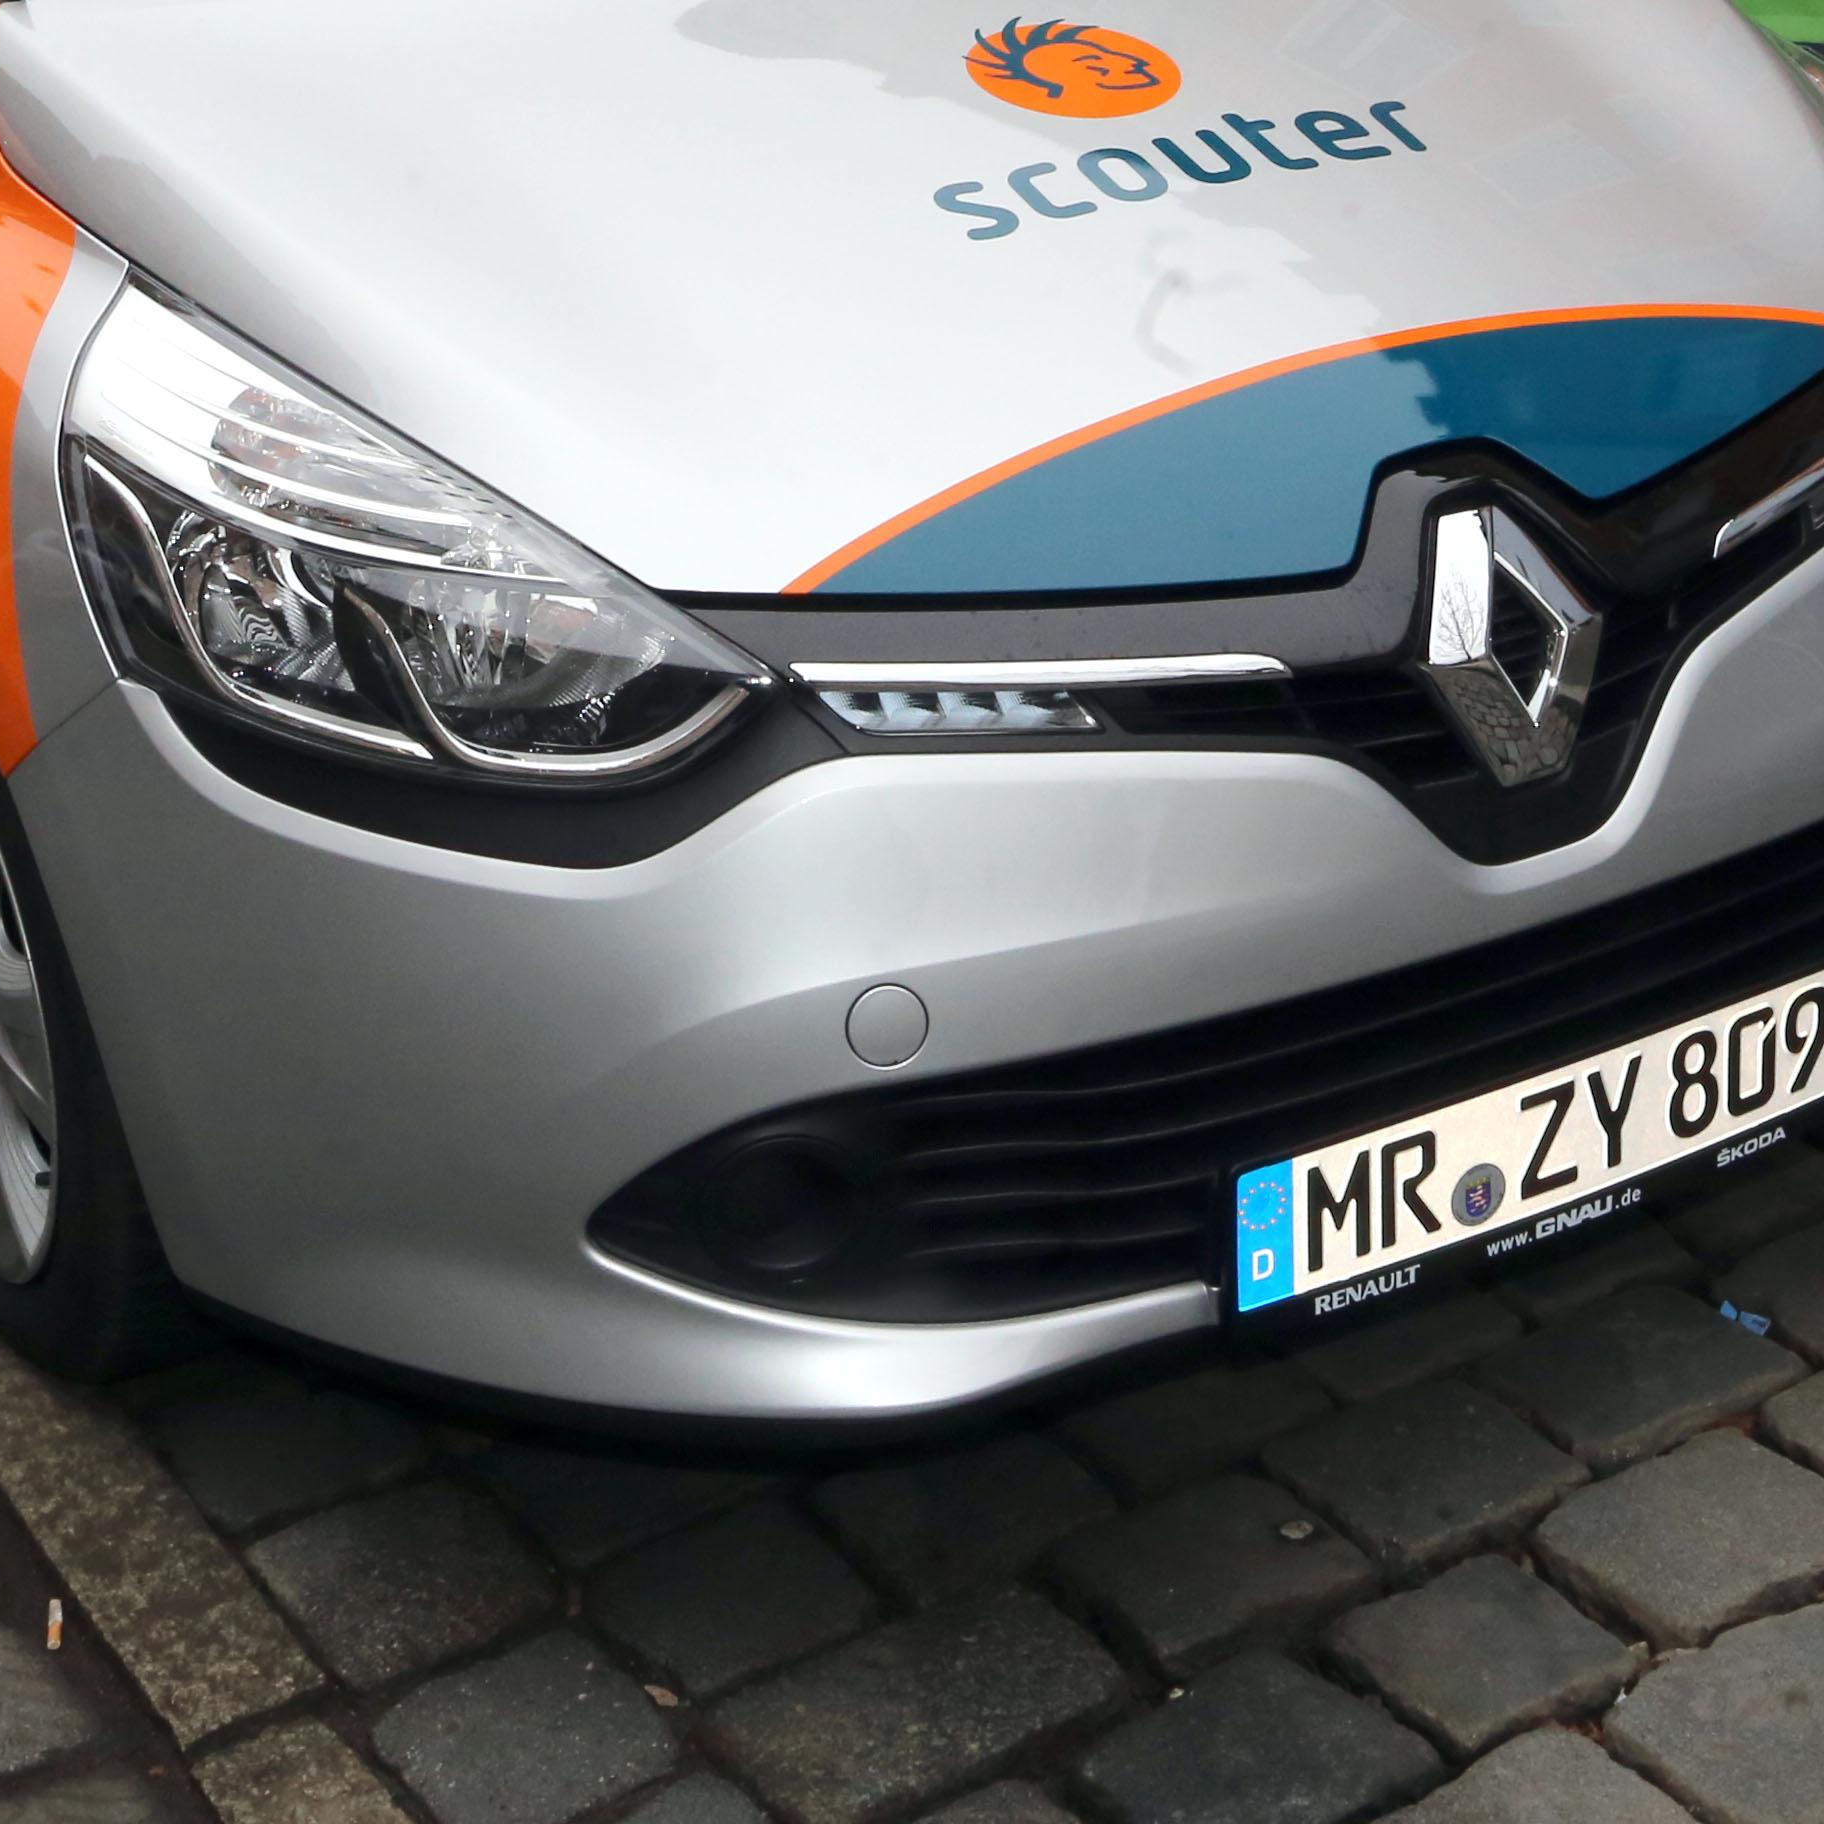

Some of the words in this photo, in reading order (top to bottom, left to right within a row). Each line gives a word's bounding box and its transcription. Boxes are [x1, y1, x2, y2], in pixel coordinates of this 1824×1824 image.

[932, 100, 1428, 242] scouter
[1306, 1128, 1443, 1274] MR
[1519, 1054, 1643, 1201] ZY
[1716, 1126, 1787, 1169] ŠKODA
[1486, 1186, 1642, 1258] www.GNAU.de
[1251, 1248, 1276, 1282] D
[1313, 1263, 1422, 1316] RENAULT
